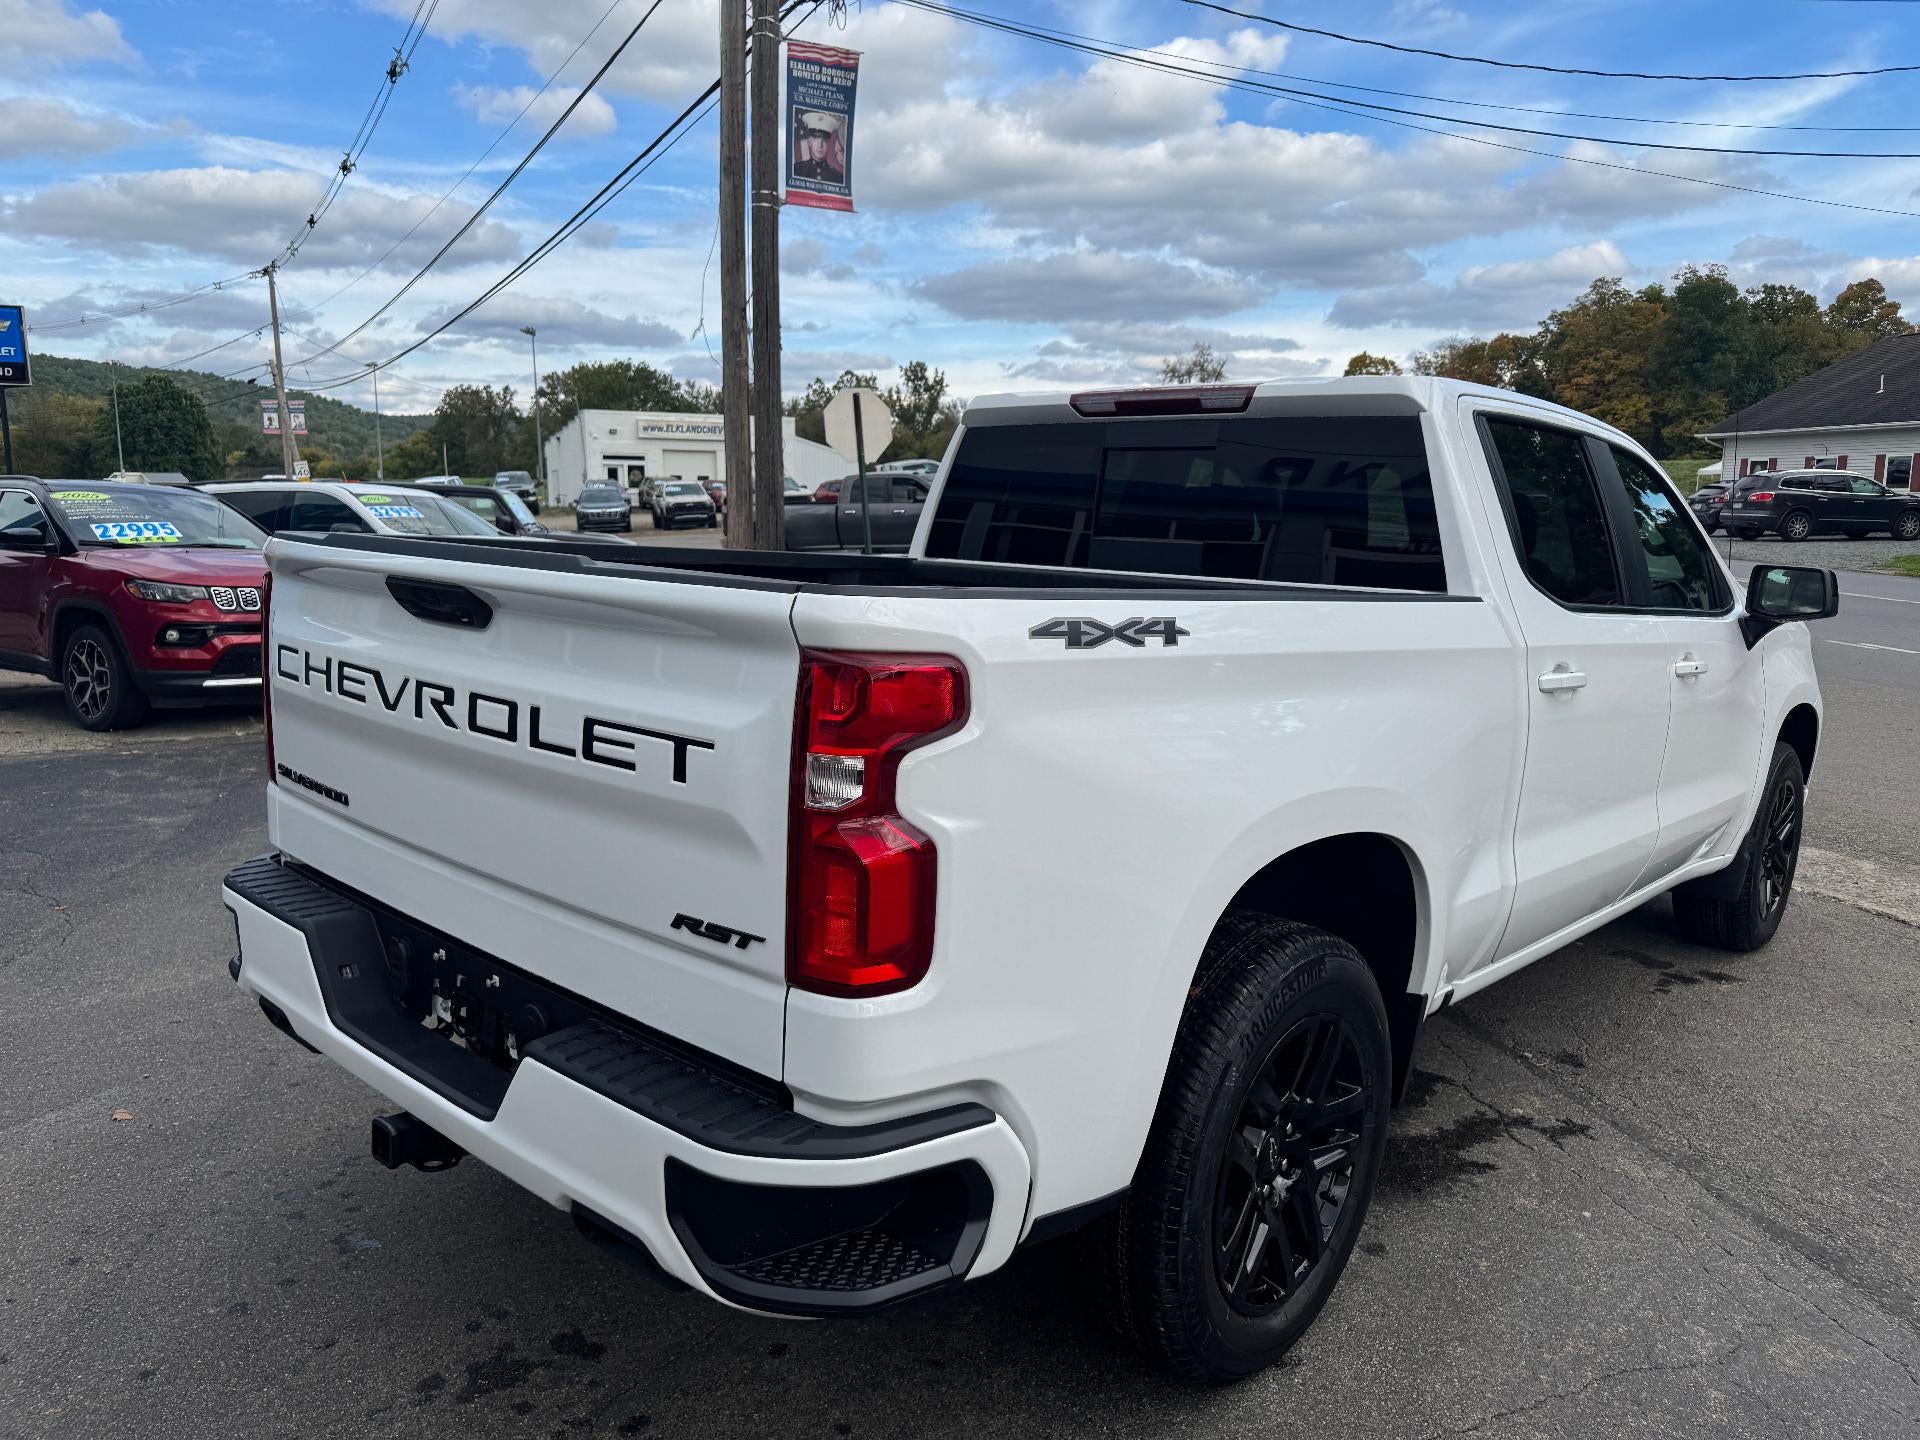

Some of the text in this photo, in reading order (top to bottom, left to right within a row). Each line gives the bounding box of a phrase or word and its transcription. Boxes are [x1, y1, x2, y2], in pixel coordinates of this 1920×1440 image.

[789, 60, 856, 80] ELKLAND BOROUGH
[792, 68, 852, 87] HOMETOWN HERO
[61, 491, 100, 499] 2025
[95, 523, 176, 539] 22995
[1028, 617, 1190, 649] 4X4
[277, 643, 716, 785] CHEVROLET
[278, 763, 350, 807] SILVERADO
[670, 912, 767, 950] RST
